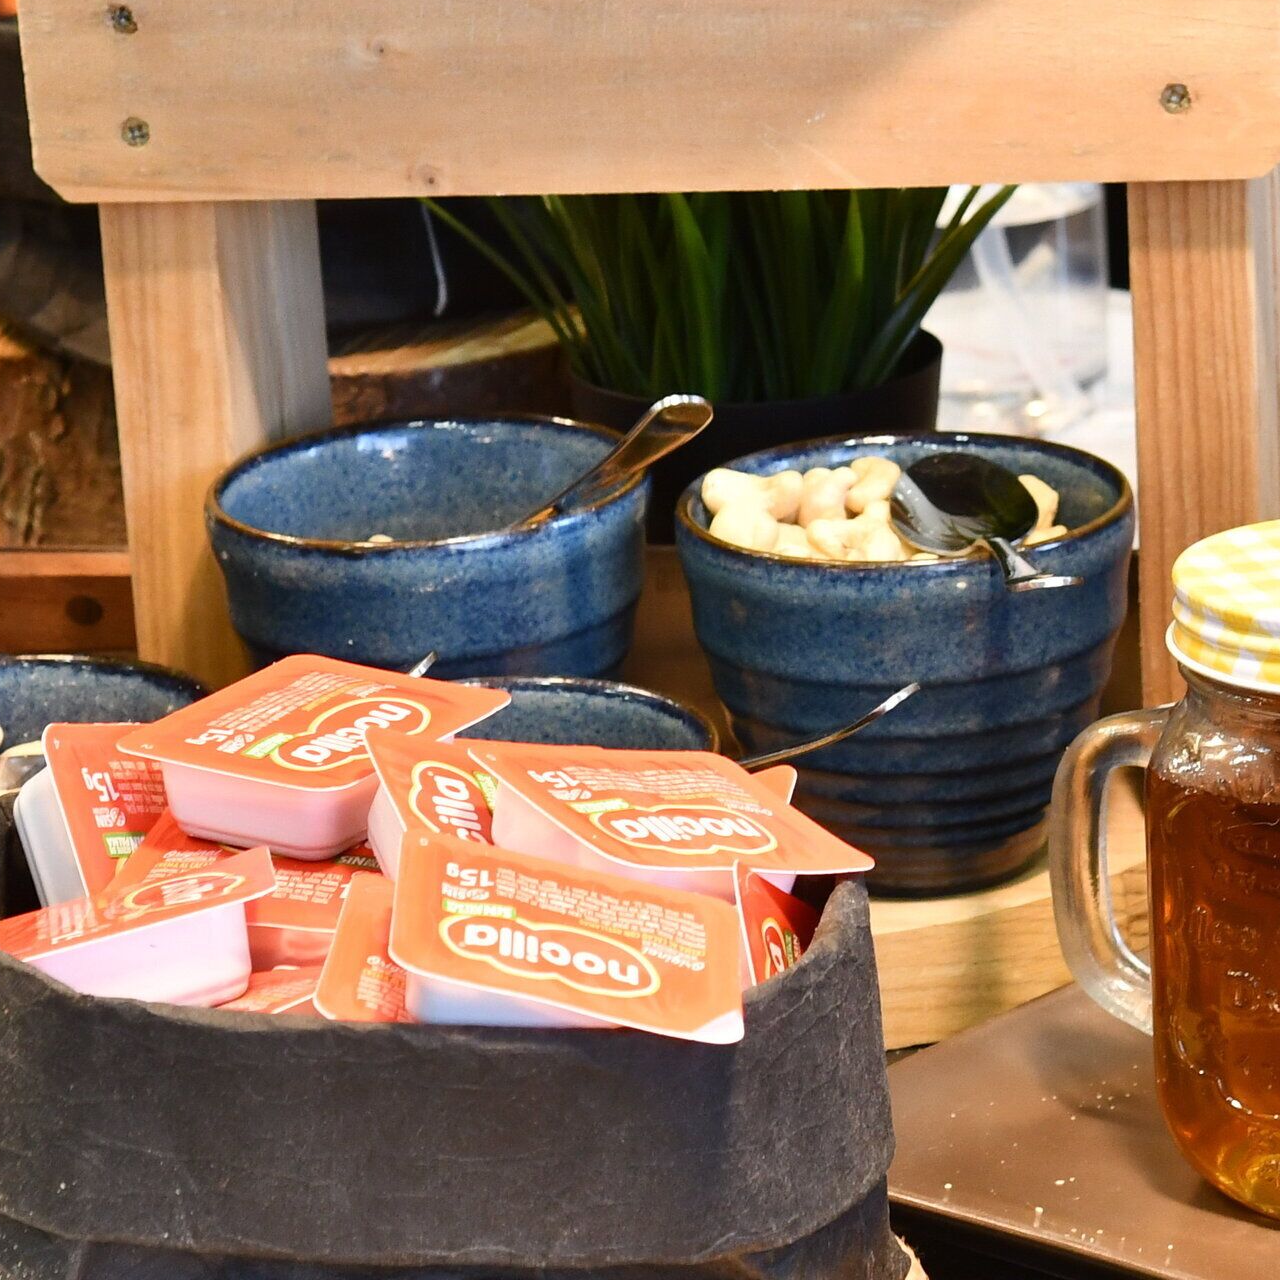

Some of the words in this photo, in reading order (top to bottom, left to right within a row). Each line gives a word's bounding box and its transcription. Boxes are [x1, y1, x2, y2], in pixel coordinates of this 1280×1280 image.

[81, 767, 120, 802] 15g
[609, 816, 762, 842] nocilla
[445, 861, 495, 887] 15g
[463, 923, 640, 986] nocilla
